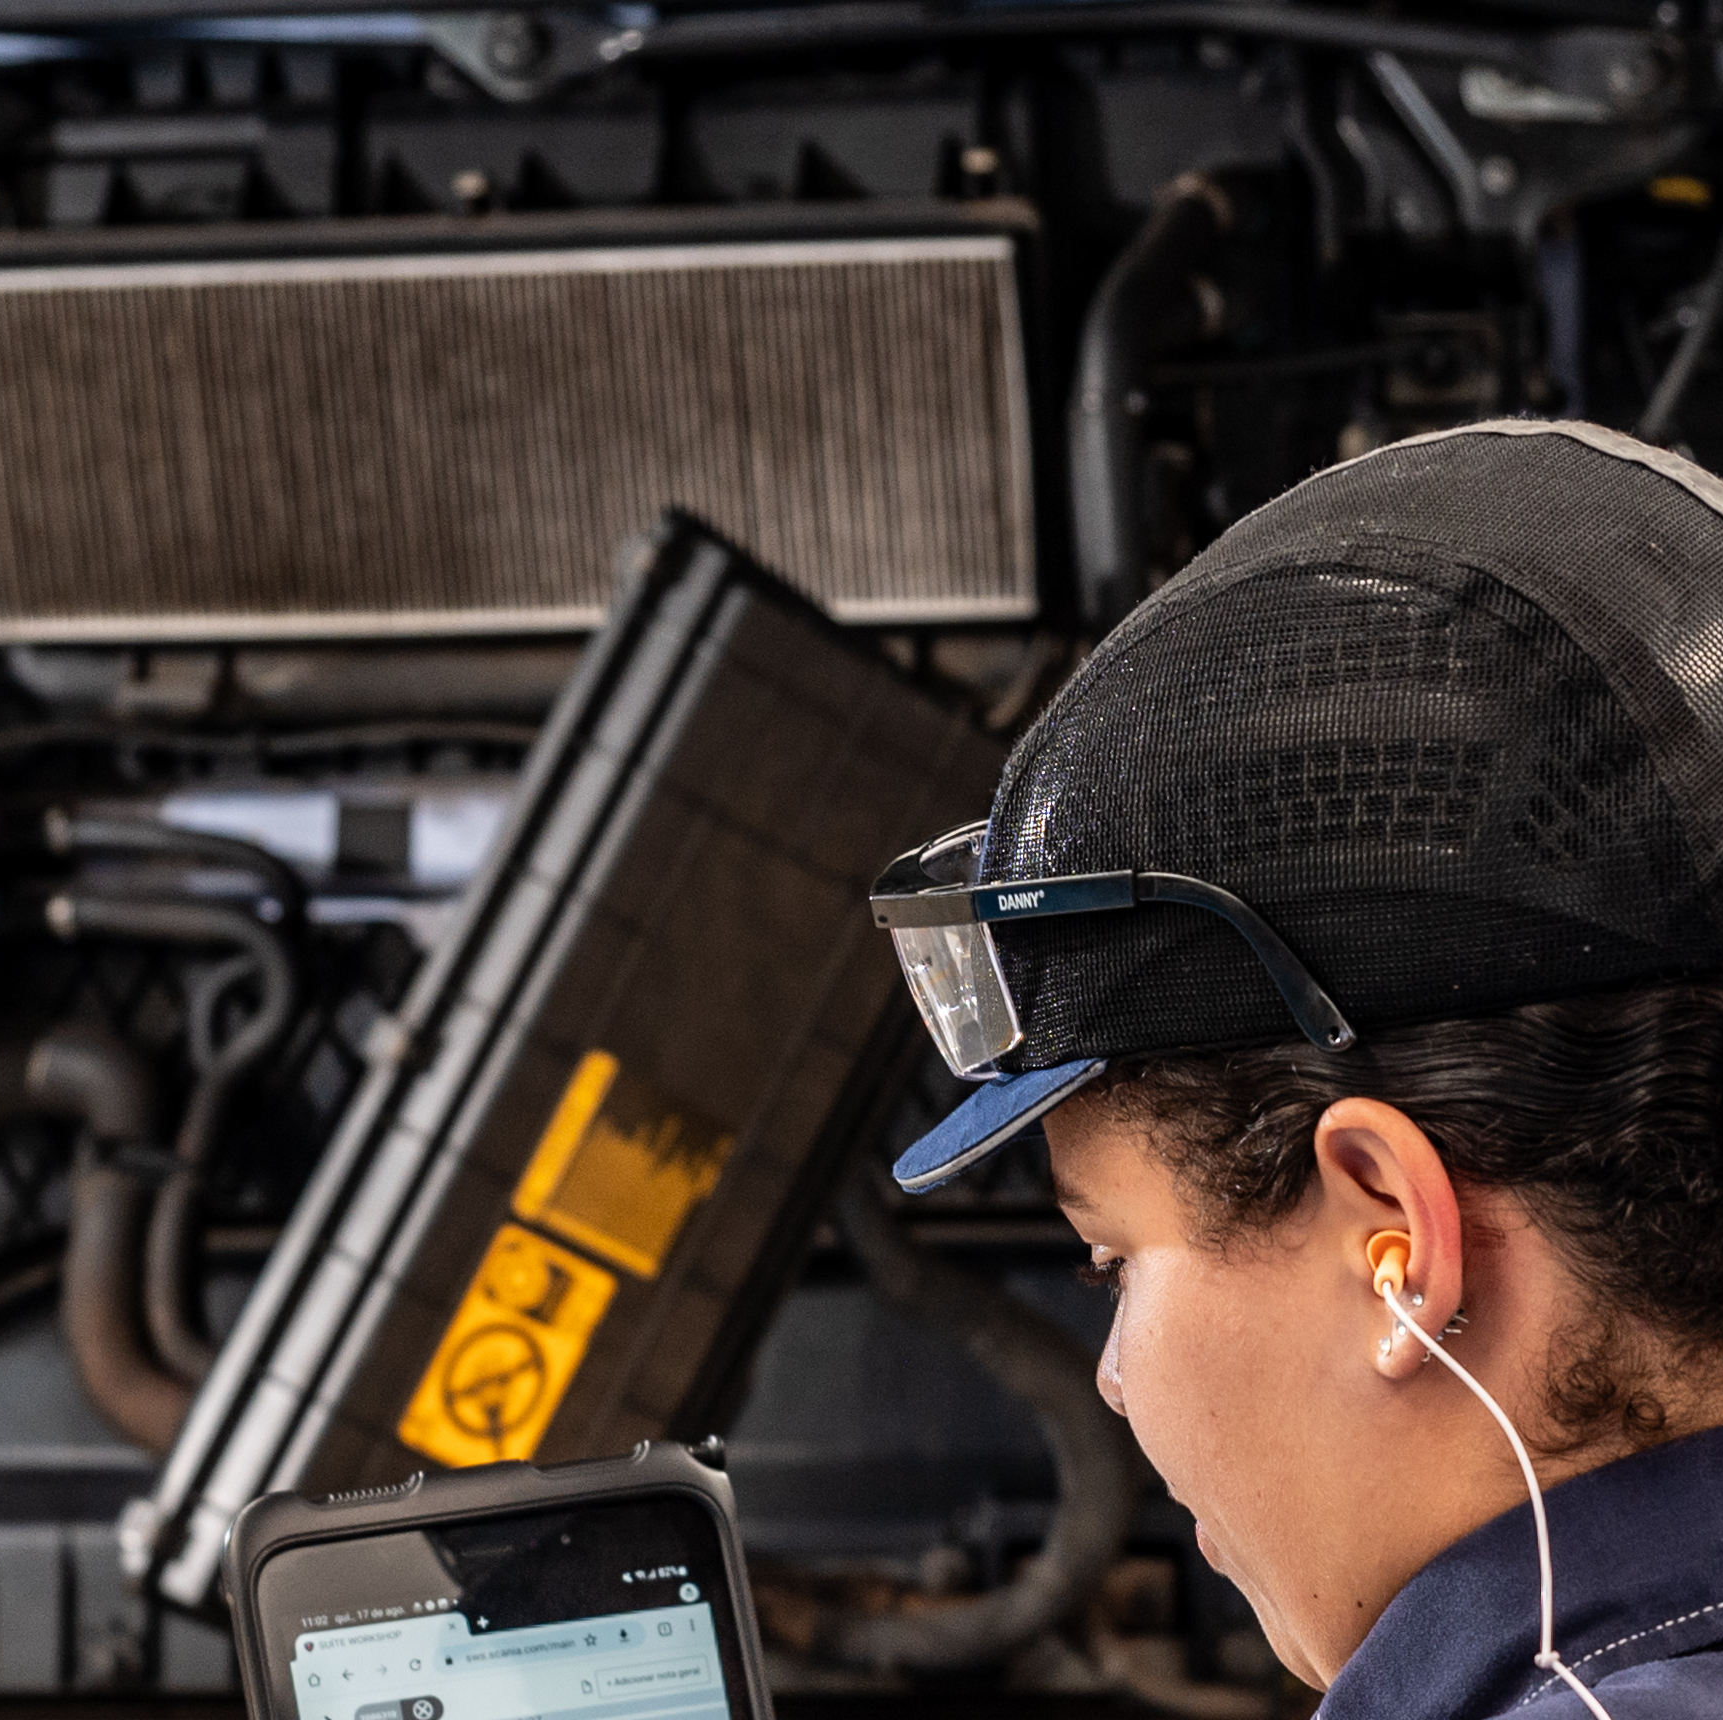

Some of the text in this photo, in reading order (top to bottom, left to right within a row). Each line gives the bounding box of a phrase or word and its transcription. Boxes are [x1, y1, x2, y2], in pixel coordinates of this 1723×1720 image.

[301, 1615, 328, 1628] 11:02
[357, 1609, 369, 1620] 17
[370, 1608, 384, 1618] de
[385, 1606, 405, 1618] ago.
[349, 1630, 403, 1646] WORKSHOP
[466, 1637, 576, 1663] sws.scania.com/main
[614, 1672, 654, 1686] Adicionar
[657, 1669, 676, 1682] nota
[678, 1666, 701, 1680] geral
